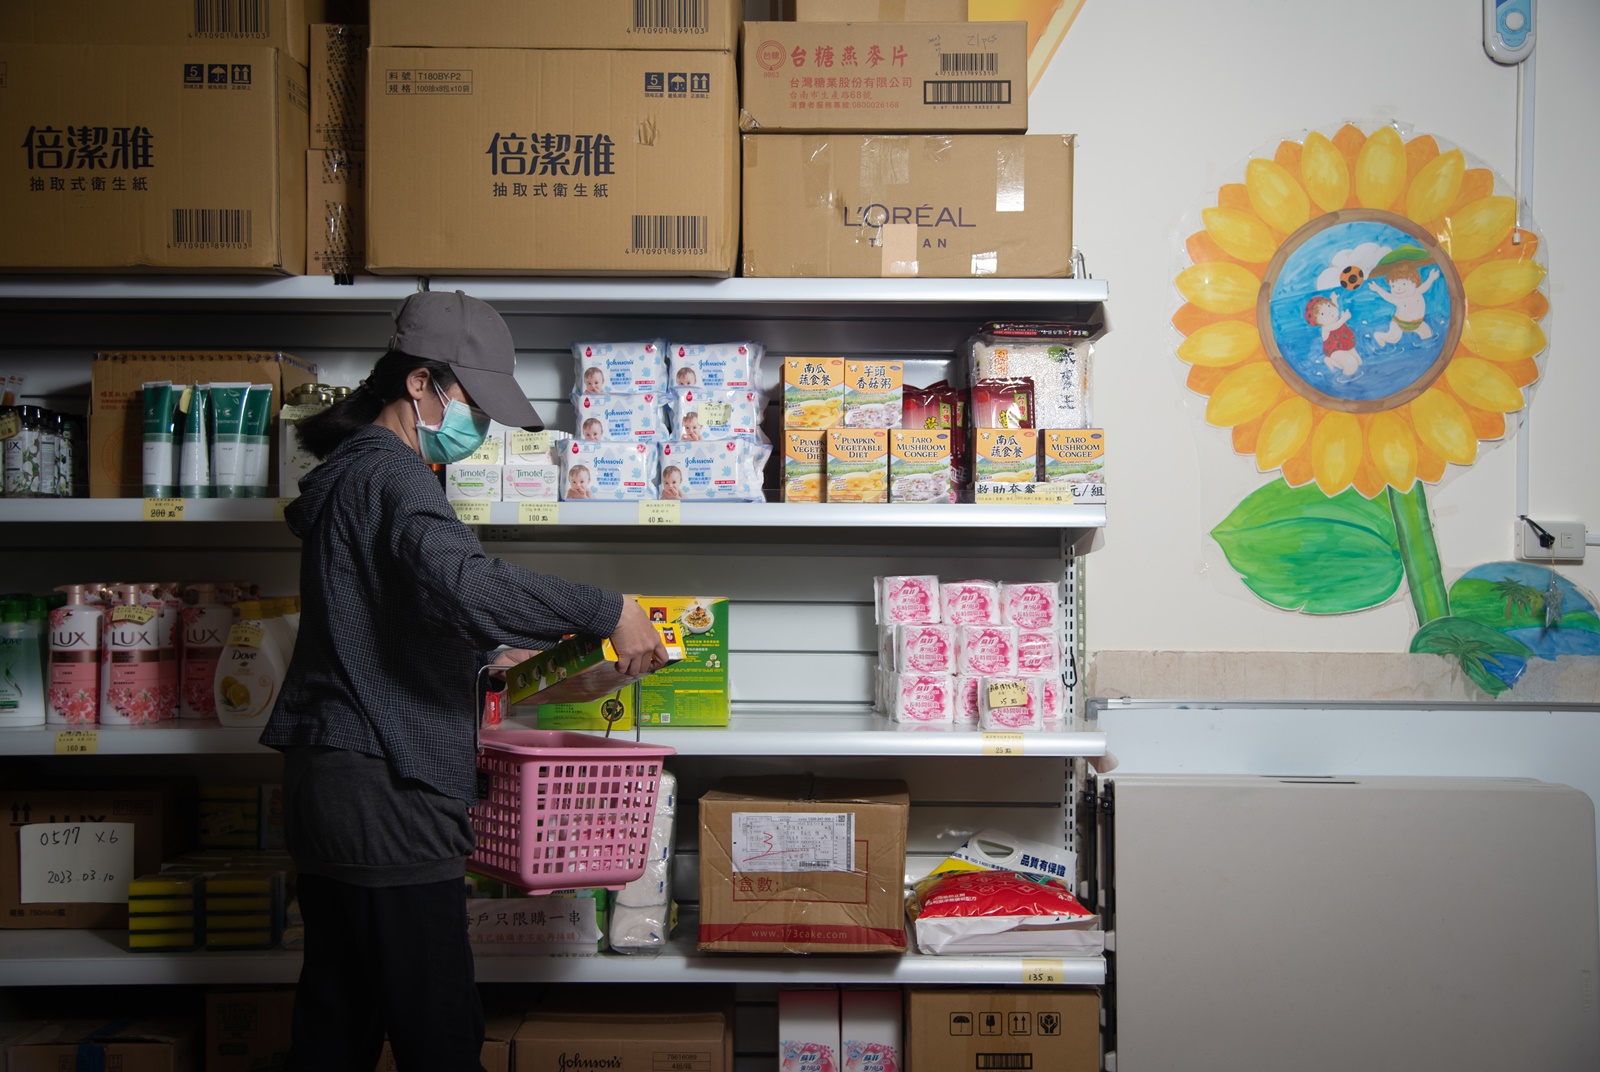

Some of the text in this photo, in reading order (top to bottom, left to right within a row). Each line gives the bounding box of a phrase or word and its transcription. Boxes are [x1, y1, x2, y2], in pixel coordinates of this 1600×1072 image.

[763, 51, 780, 60] 台糖
[790, 45, 909, 68] 台糖燕麥片
[388, 72, 461, 80] 料號 T180BY-P2
[789, 77, 913, 88] 台灣糖業股份有限公司
[388, 84, 411, 93] 規格
[21, 125, 154, 170] 倍潔雅
[485, 132, 616, 177] 倍潔雅
[30, 176, 148, 192] 抽取式衛生紙
[492, 182, 608, 198] 抽取式衛生紙
[844, 204, 976, 228] L'ORÉAL
[804, 363, 826, 374] 南瓜
[864, 366, 886, 377] 芋頭
[798, 374, 832, 386] 蔬食餐
[856, 378, 892, 390] 香菇粥
[6, 441, 21, 450] UX
[996, 435, 1018, 446] 南瓜
[1064, 436, 1087, 444] TARO
[834, 444, 883, 452] VEGETABLE
[990, 446, 1024, 458] 蔬食餐
[594, 457, 624, 468] Johnson's
[685, 457, 714, 468] Johnson's
[459, 469, 486, 478] Timotei
[516, 469, 543, 478] Timotei
[52, 632, 90, 648] LUX
[112, 632, 152, 648] LUX
[186, 630, 222, 644] LUX
[232, 650, 257, 660] Dove
[1020, 854, 1067, 877] 品質有保證
[751, 928, 848, 940] www.173cake.com
[1028, 973, 1044, 982] 135
[558, 1052, 621, 1072] Johnson's
